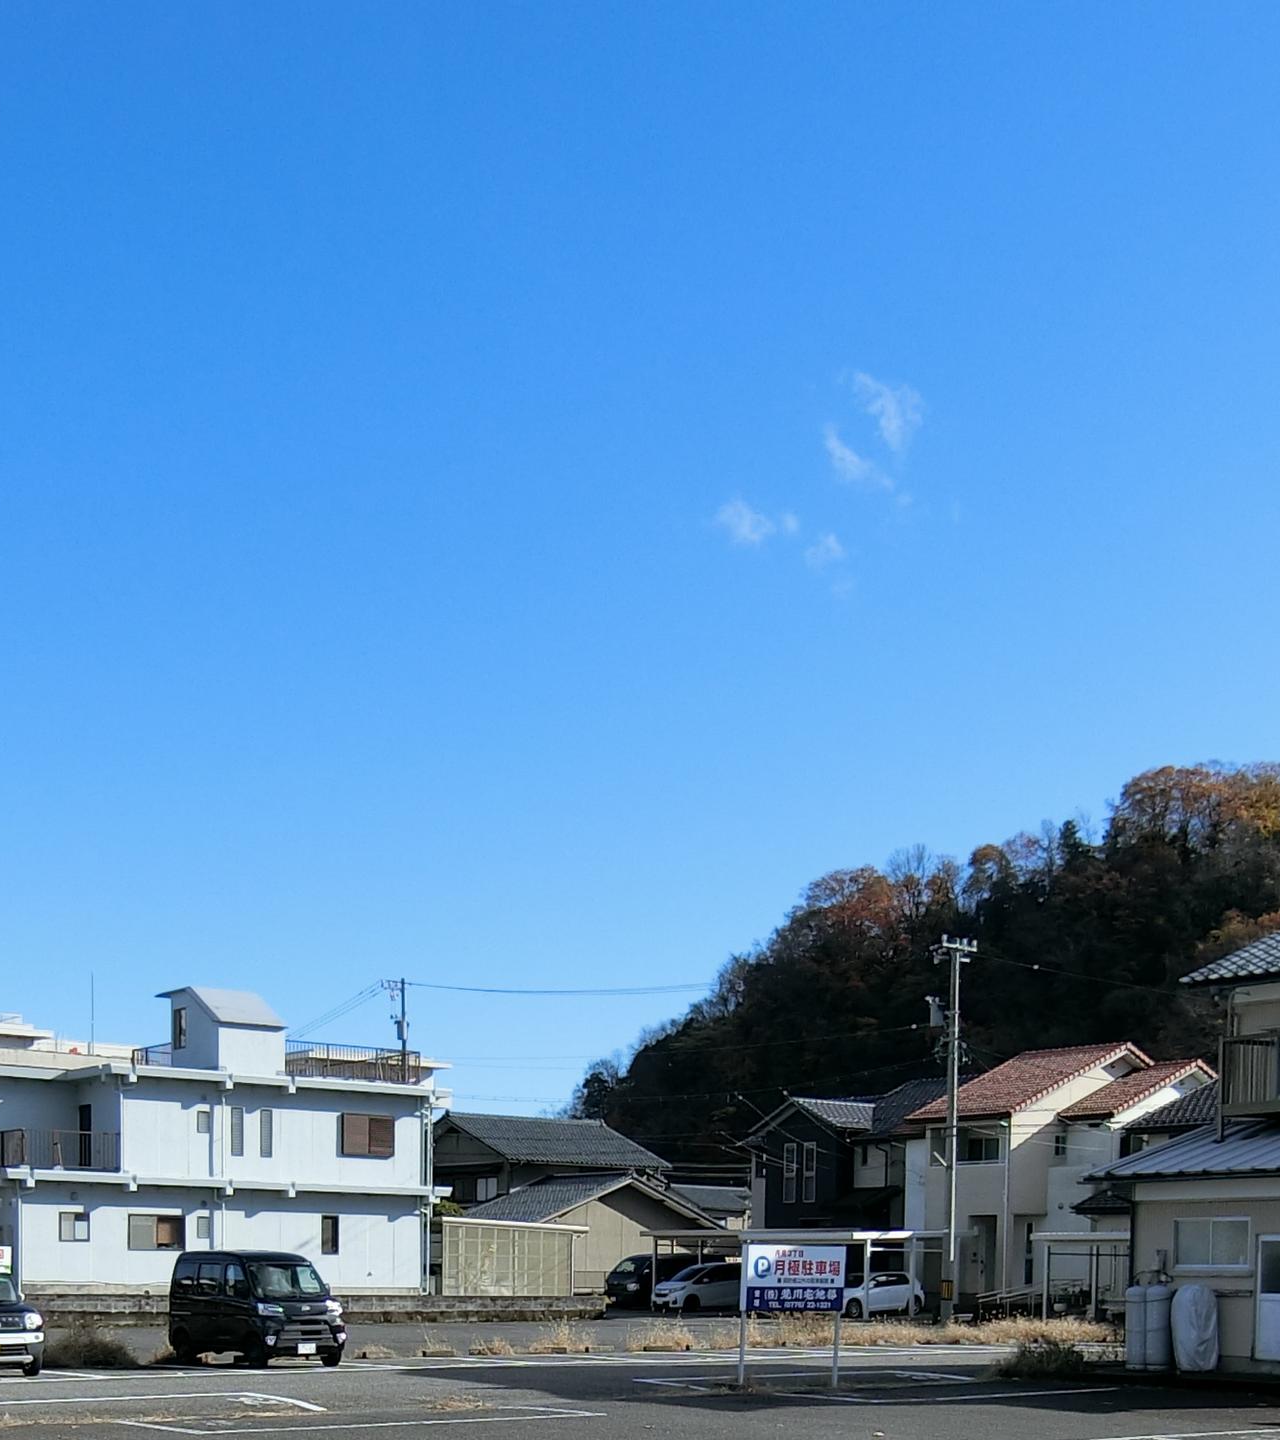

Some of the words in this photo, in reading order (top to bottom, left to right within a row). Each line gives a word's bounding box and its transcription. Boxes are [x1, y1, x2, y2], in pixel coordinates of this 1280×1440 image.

[774, 1260, 840, 1277] 月極駐車場
